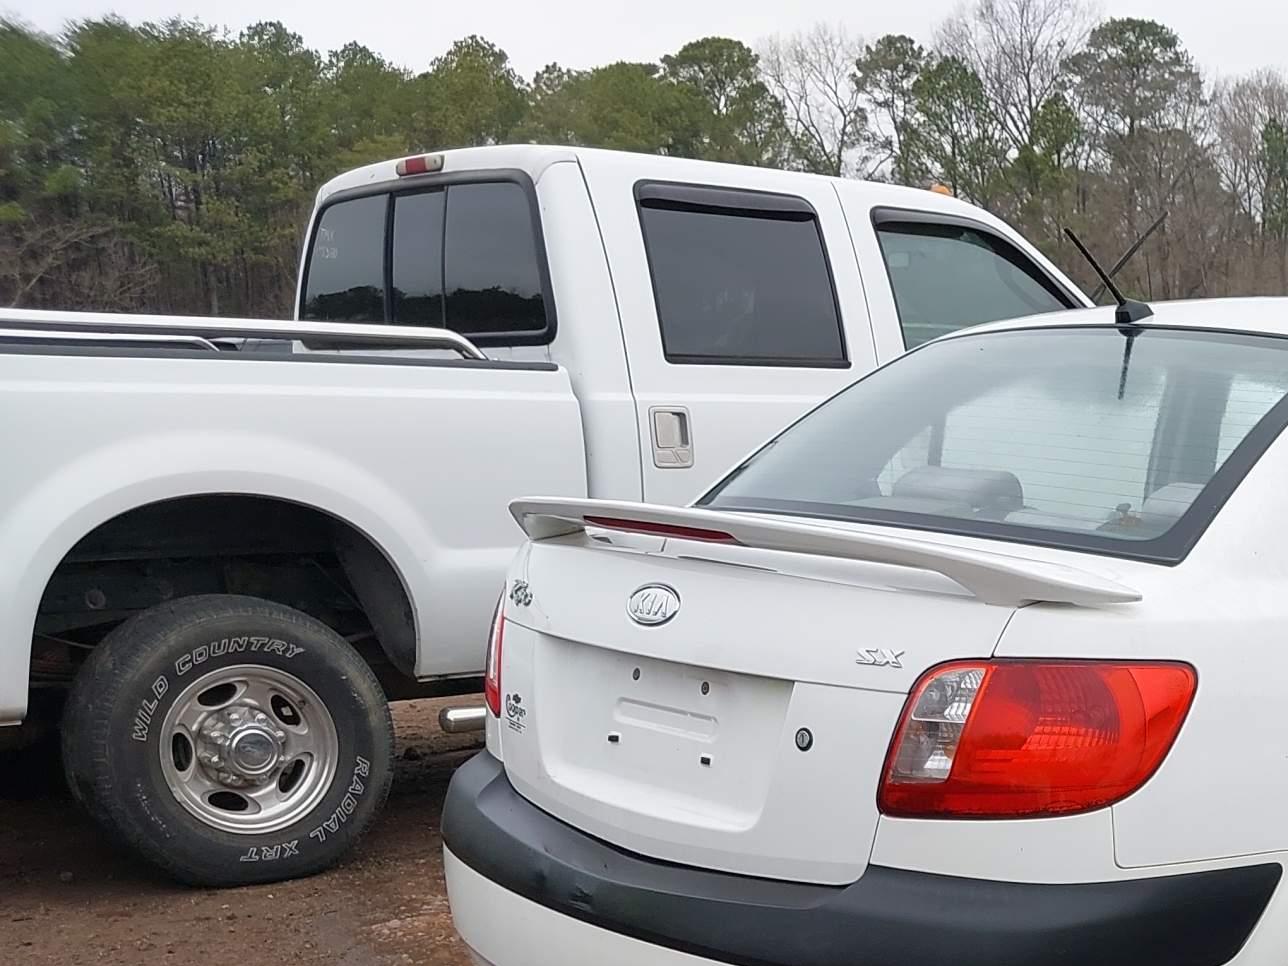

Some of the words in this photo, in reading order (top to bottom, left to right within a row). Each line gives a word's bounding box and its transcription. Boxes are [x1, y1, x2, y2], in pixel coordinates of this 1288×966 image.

[633, 591, 669, 618] KIA
[855, 648, 905, 669] SX
[131, 675, 169, 742] WILD
[174, 636, 307, 676] COUNTRY
[309, 755, 371, 843] RADIAL
[239, 839, 300, 862] XRT
